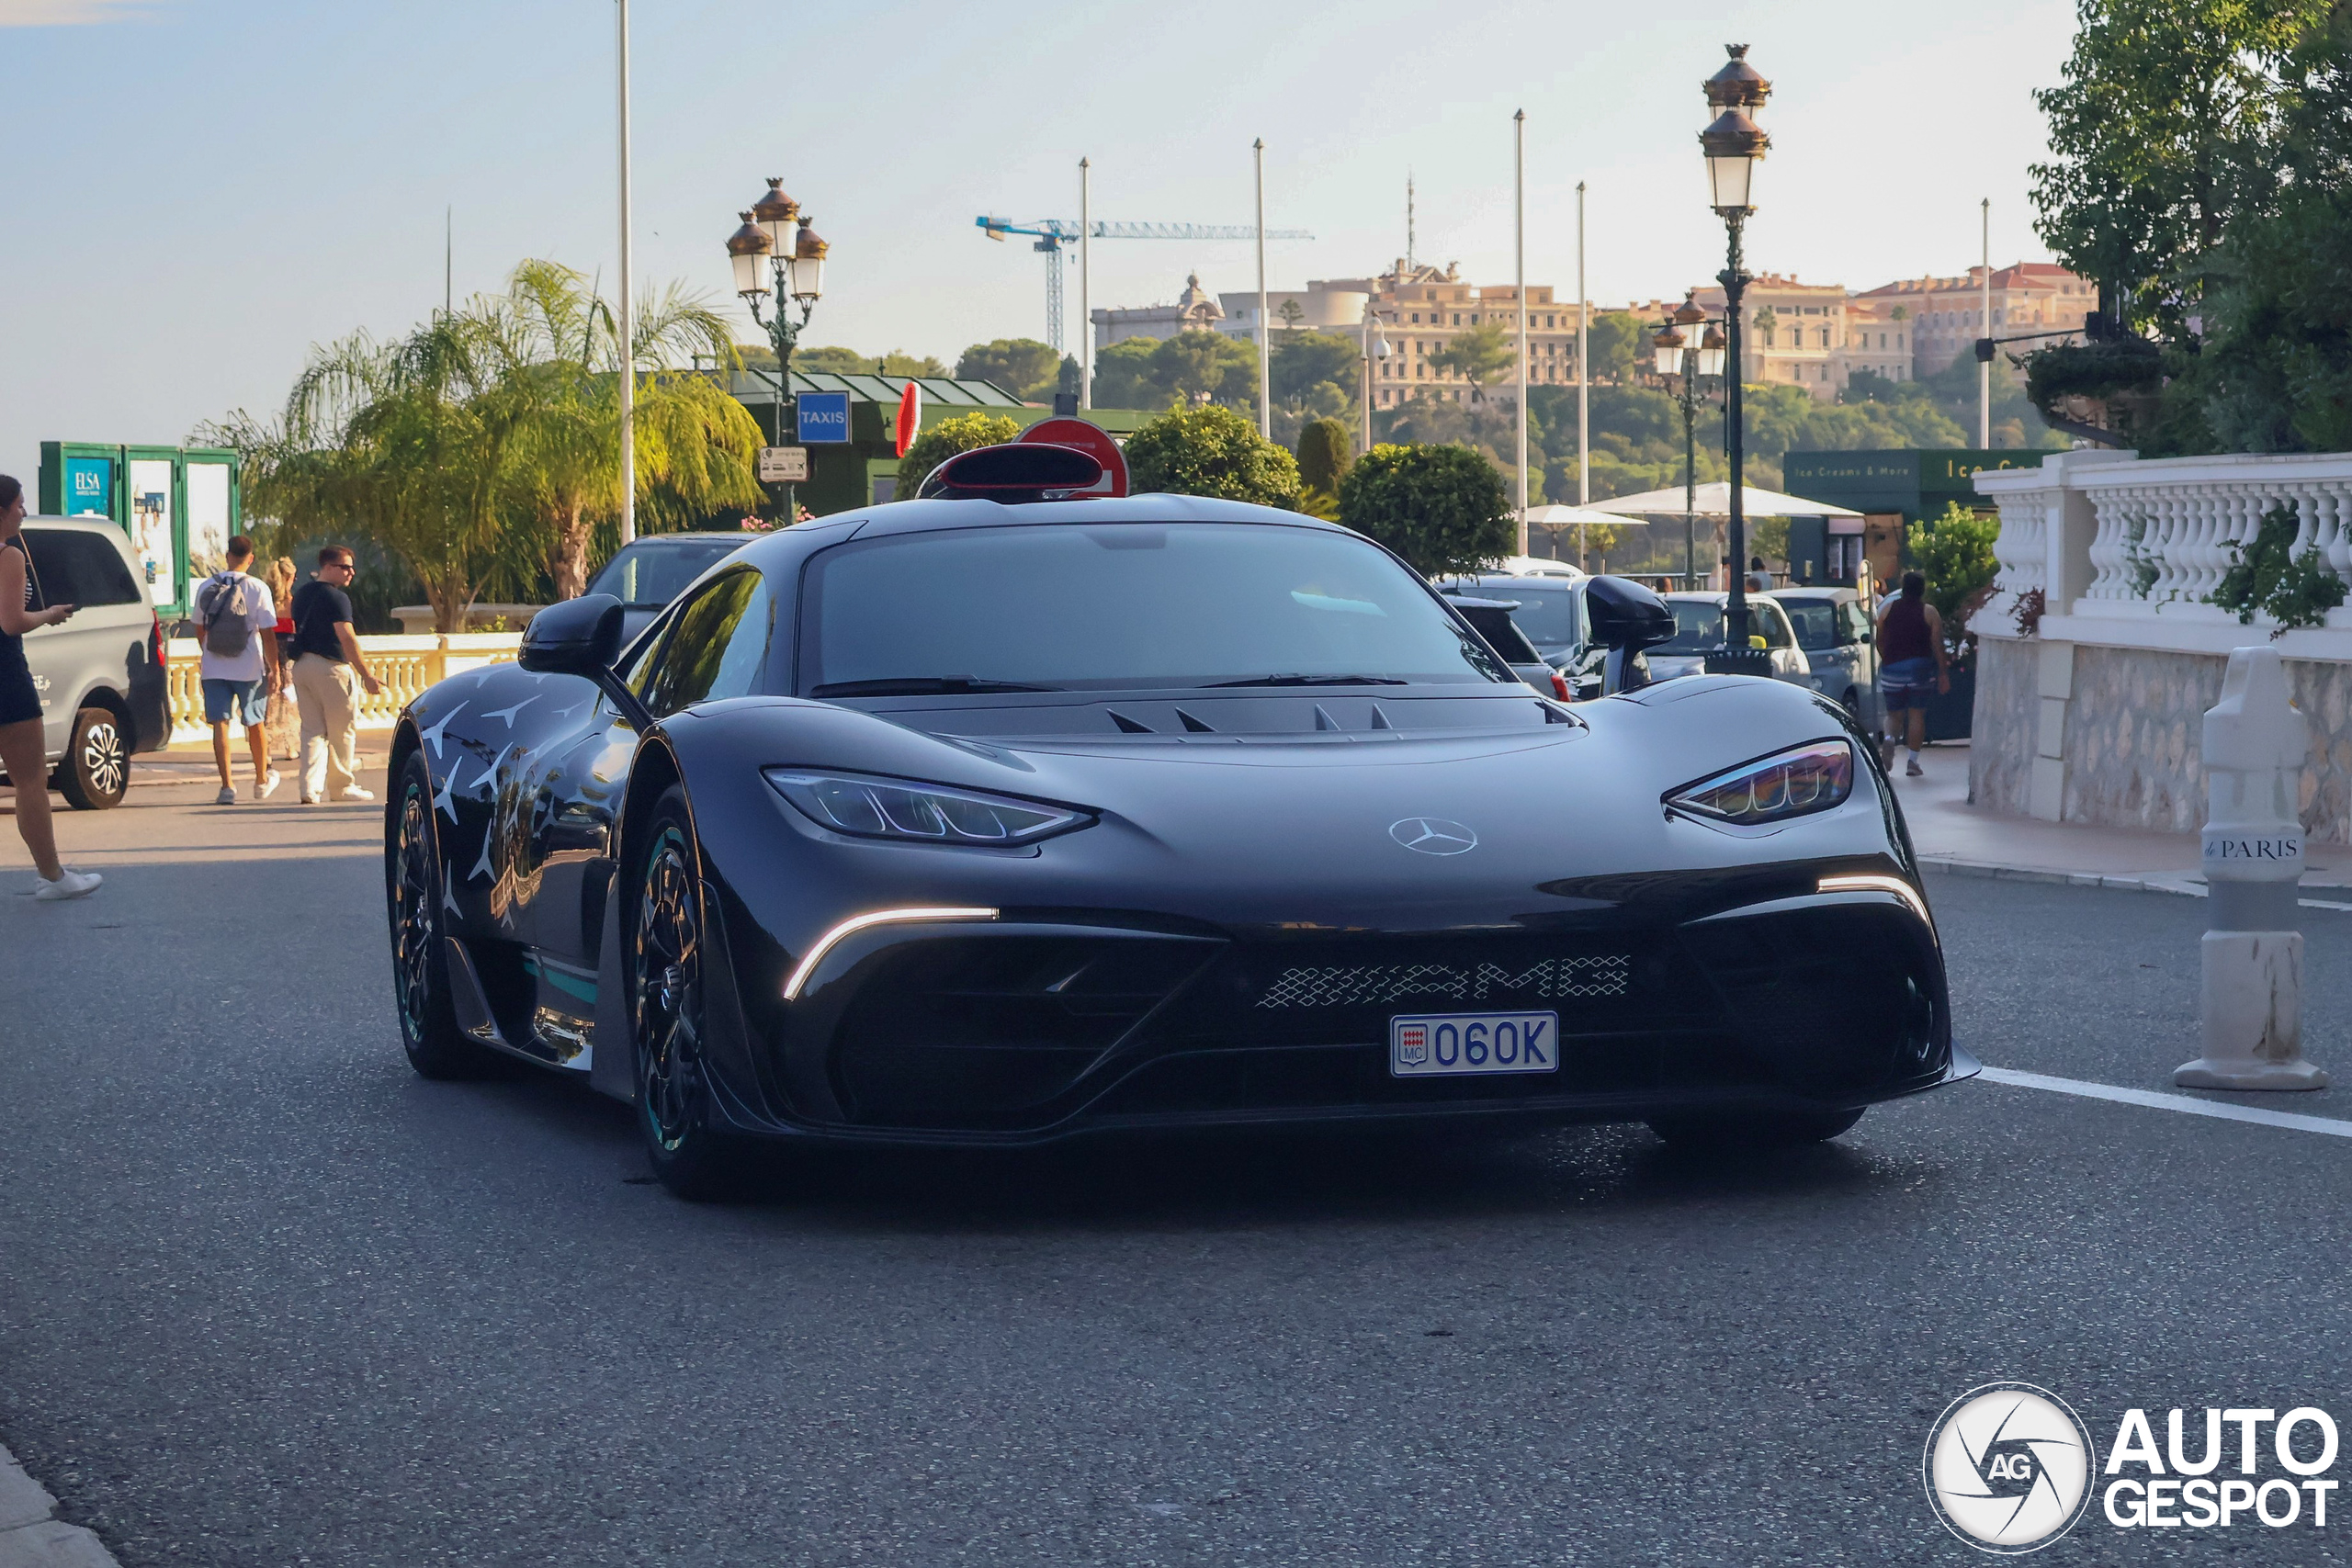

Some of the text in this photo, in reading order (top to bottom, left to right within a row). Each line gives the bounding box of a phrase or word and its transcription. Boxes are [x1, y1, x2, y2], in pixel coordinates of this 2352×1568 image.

[801, 412, 845, 423] TAXIS
[75, 471, 100, 491] ELSA
[2222, 839, 2297, 860] PARIS
[1404, 1047, 1423, 1059] MC
[1435, 1021, 1547, 1066] 060K
